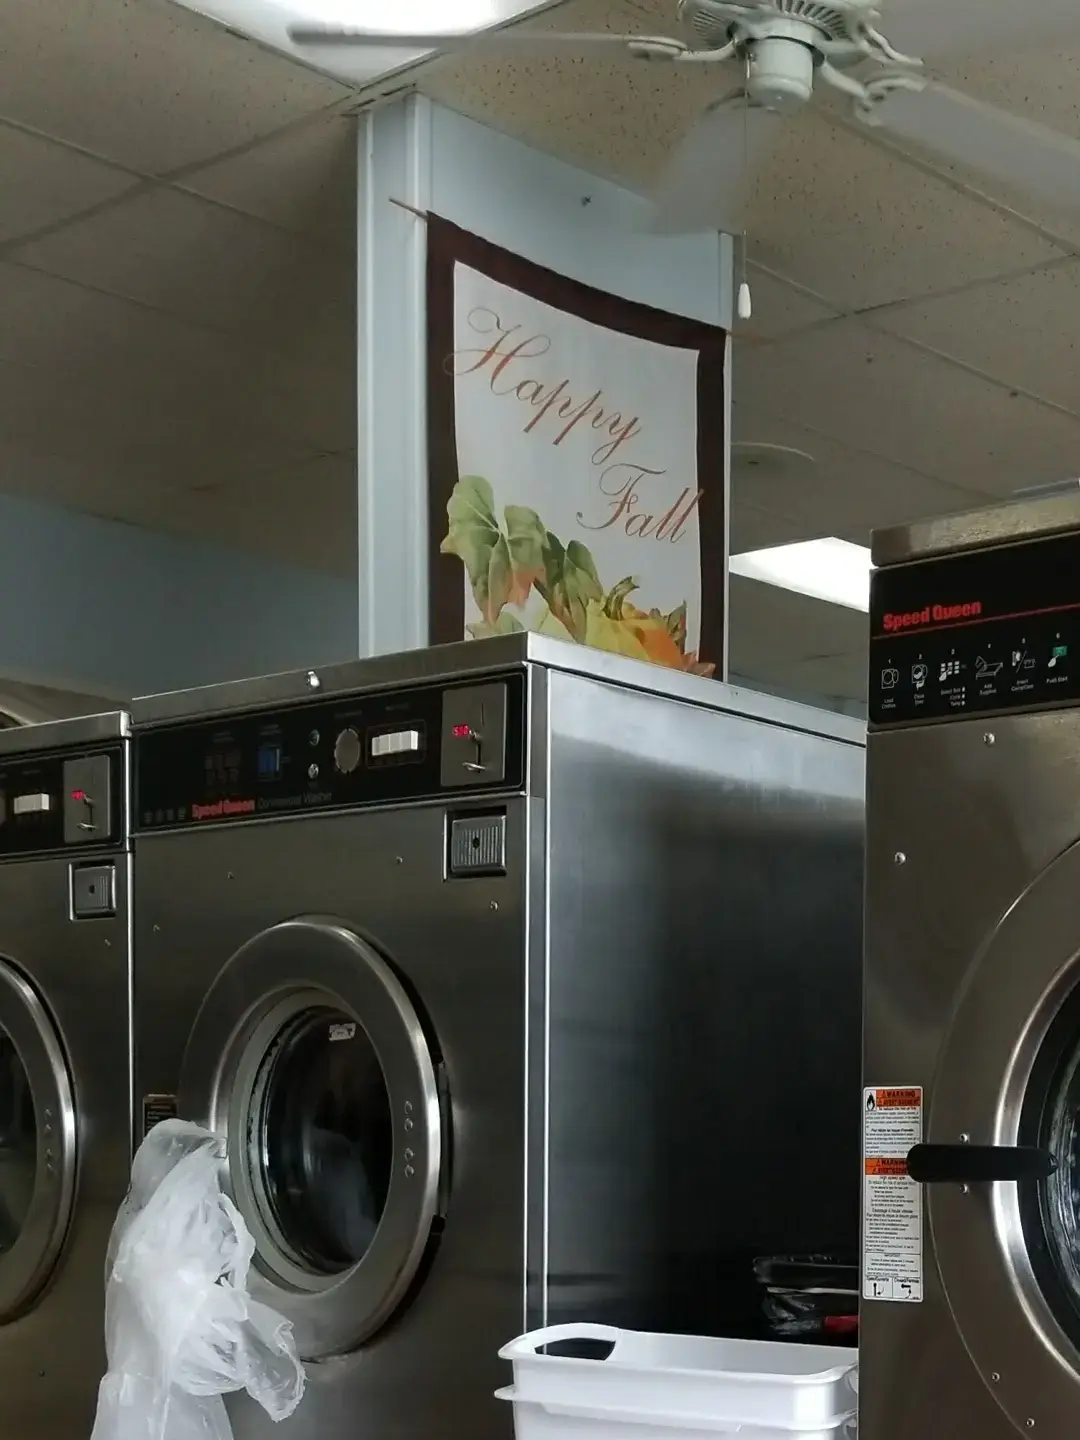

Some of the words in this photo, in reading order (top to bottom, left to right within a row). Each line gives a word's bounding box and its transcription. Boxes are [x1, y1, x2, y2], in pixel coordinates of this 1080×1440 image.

[443, 307, 642, 466] Happy
[576, 463, 705, 544] Fall
[882, 606, 930, 632] Speed
[932, 600, 983, 622] Queen
